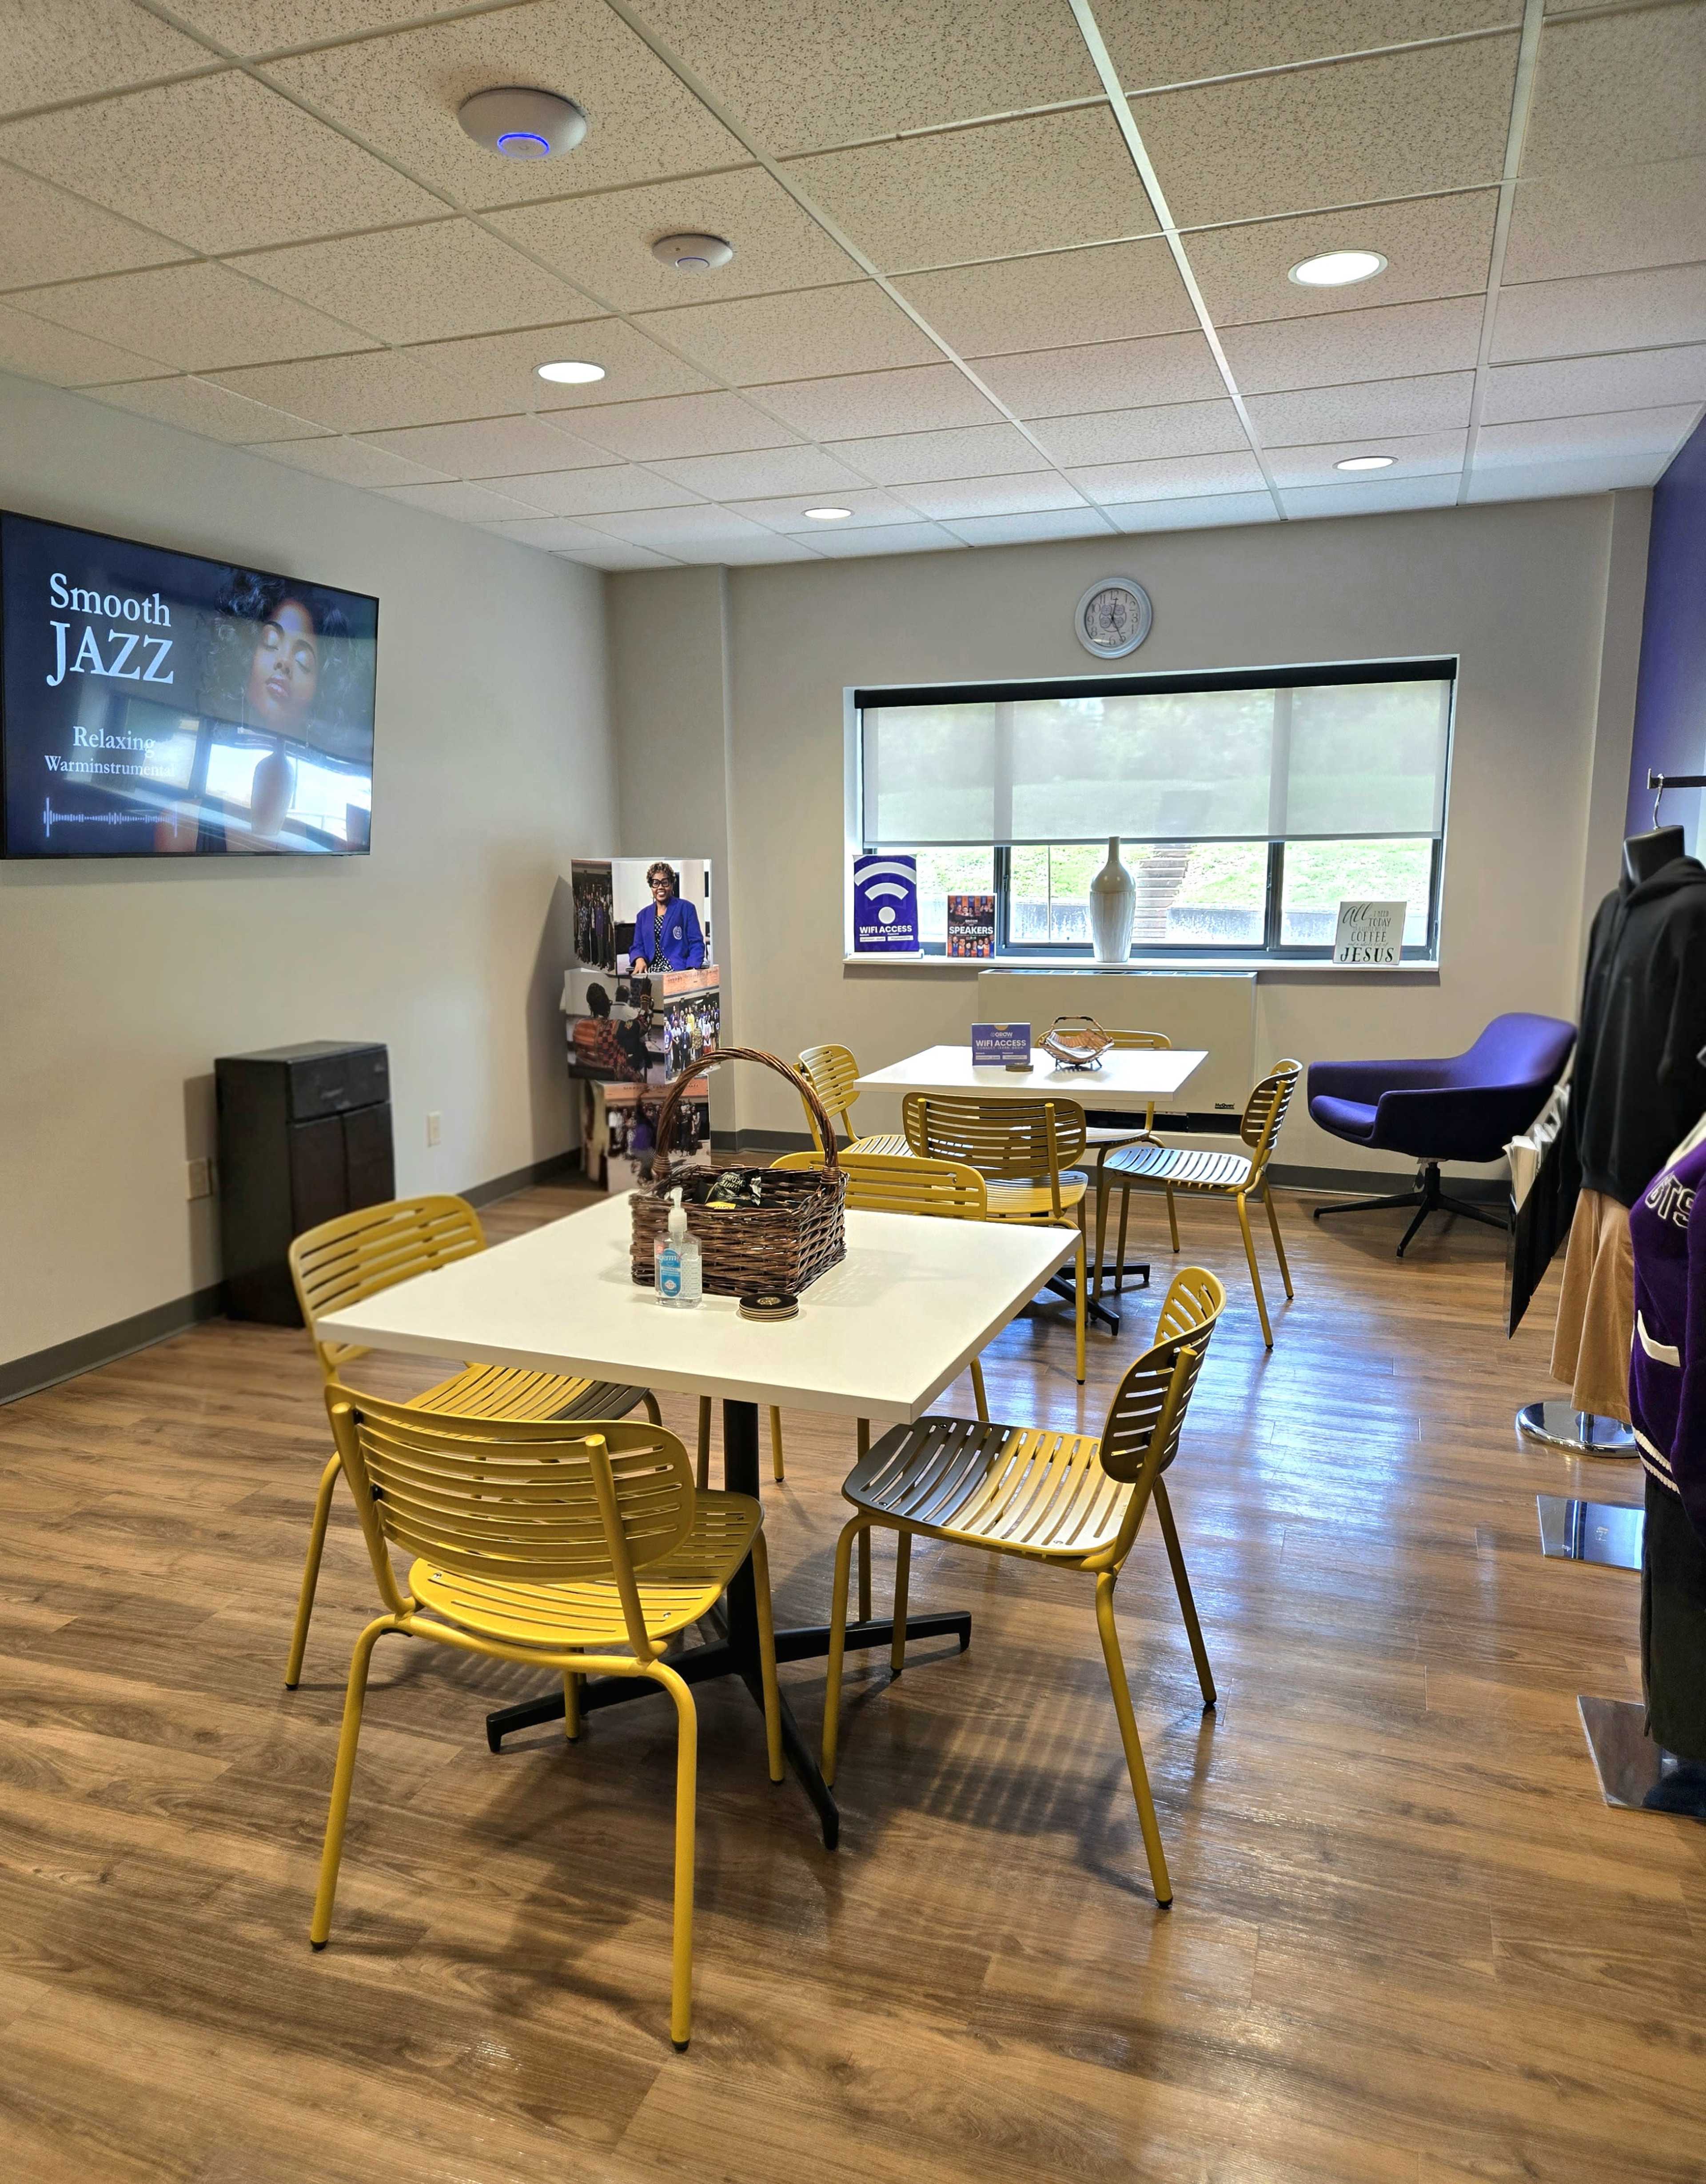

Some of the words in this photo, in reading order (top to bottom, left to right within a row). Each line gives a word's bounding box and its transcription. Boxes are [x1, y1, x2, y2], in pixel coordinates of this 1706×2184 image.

[50, 573, 171, 627] Smooth
[46, 620, 174, 687] JAZZ
[73, 726, 155, 758] Relaxing
[44, 755, 175, 777] Warminstrumental
[949, 926, 993, 934] SPEAKERS
[1369, 918, 1391, 927] TODAY
[1351, 931, 1387, 942] COFFEE
[1340, 947, 1394, 962] JESUS
